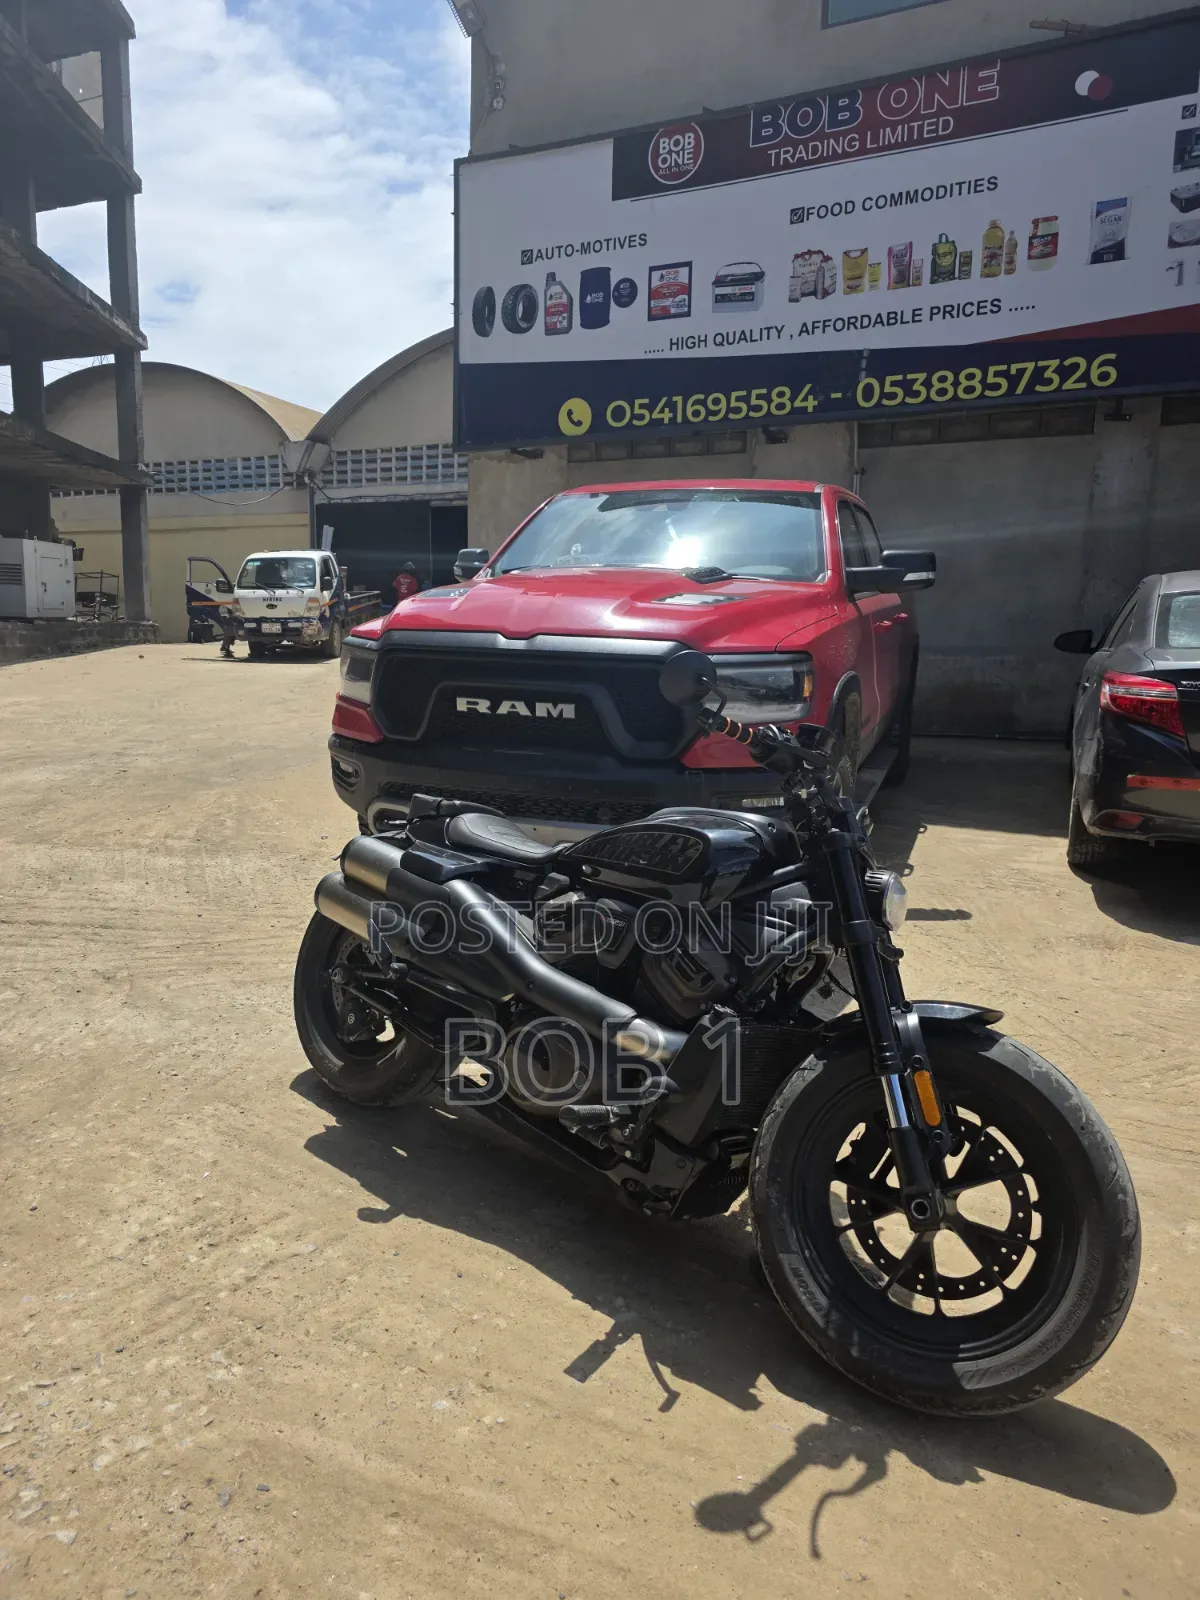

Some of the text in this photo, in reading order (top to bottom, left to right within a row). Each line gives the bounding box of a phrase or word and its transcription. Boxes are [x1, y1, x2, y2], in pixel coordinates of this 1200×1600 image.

[750, 59, 1000, 148] BOB ONE
[658, 149, 694, 168] ONE
[660, 132, 695, 154] BOB
[768, 116, 954, 167] TRADING LIMITED
[806, 175, 999, 221] FOOD COMMODITIES
[535, 233, 648, 262] AUTO-MOTIVES
[669, 334, 708, 351] HIGH
[713, 325, 786, 347] QUALITY
[798, 307, 923, 336] AFFORDABLE
[929, 298, 1002, 321] PRICES
[856, 353, 1118, 408] 0538857326
[456, 697, 576, 719] RAM
